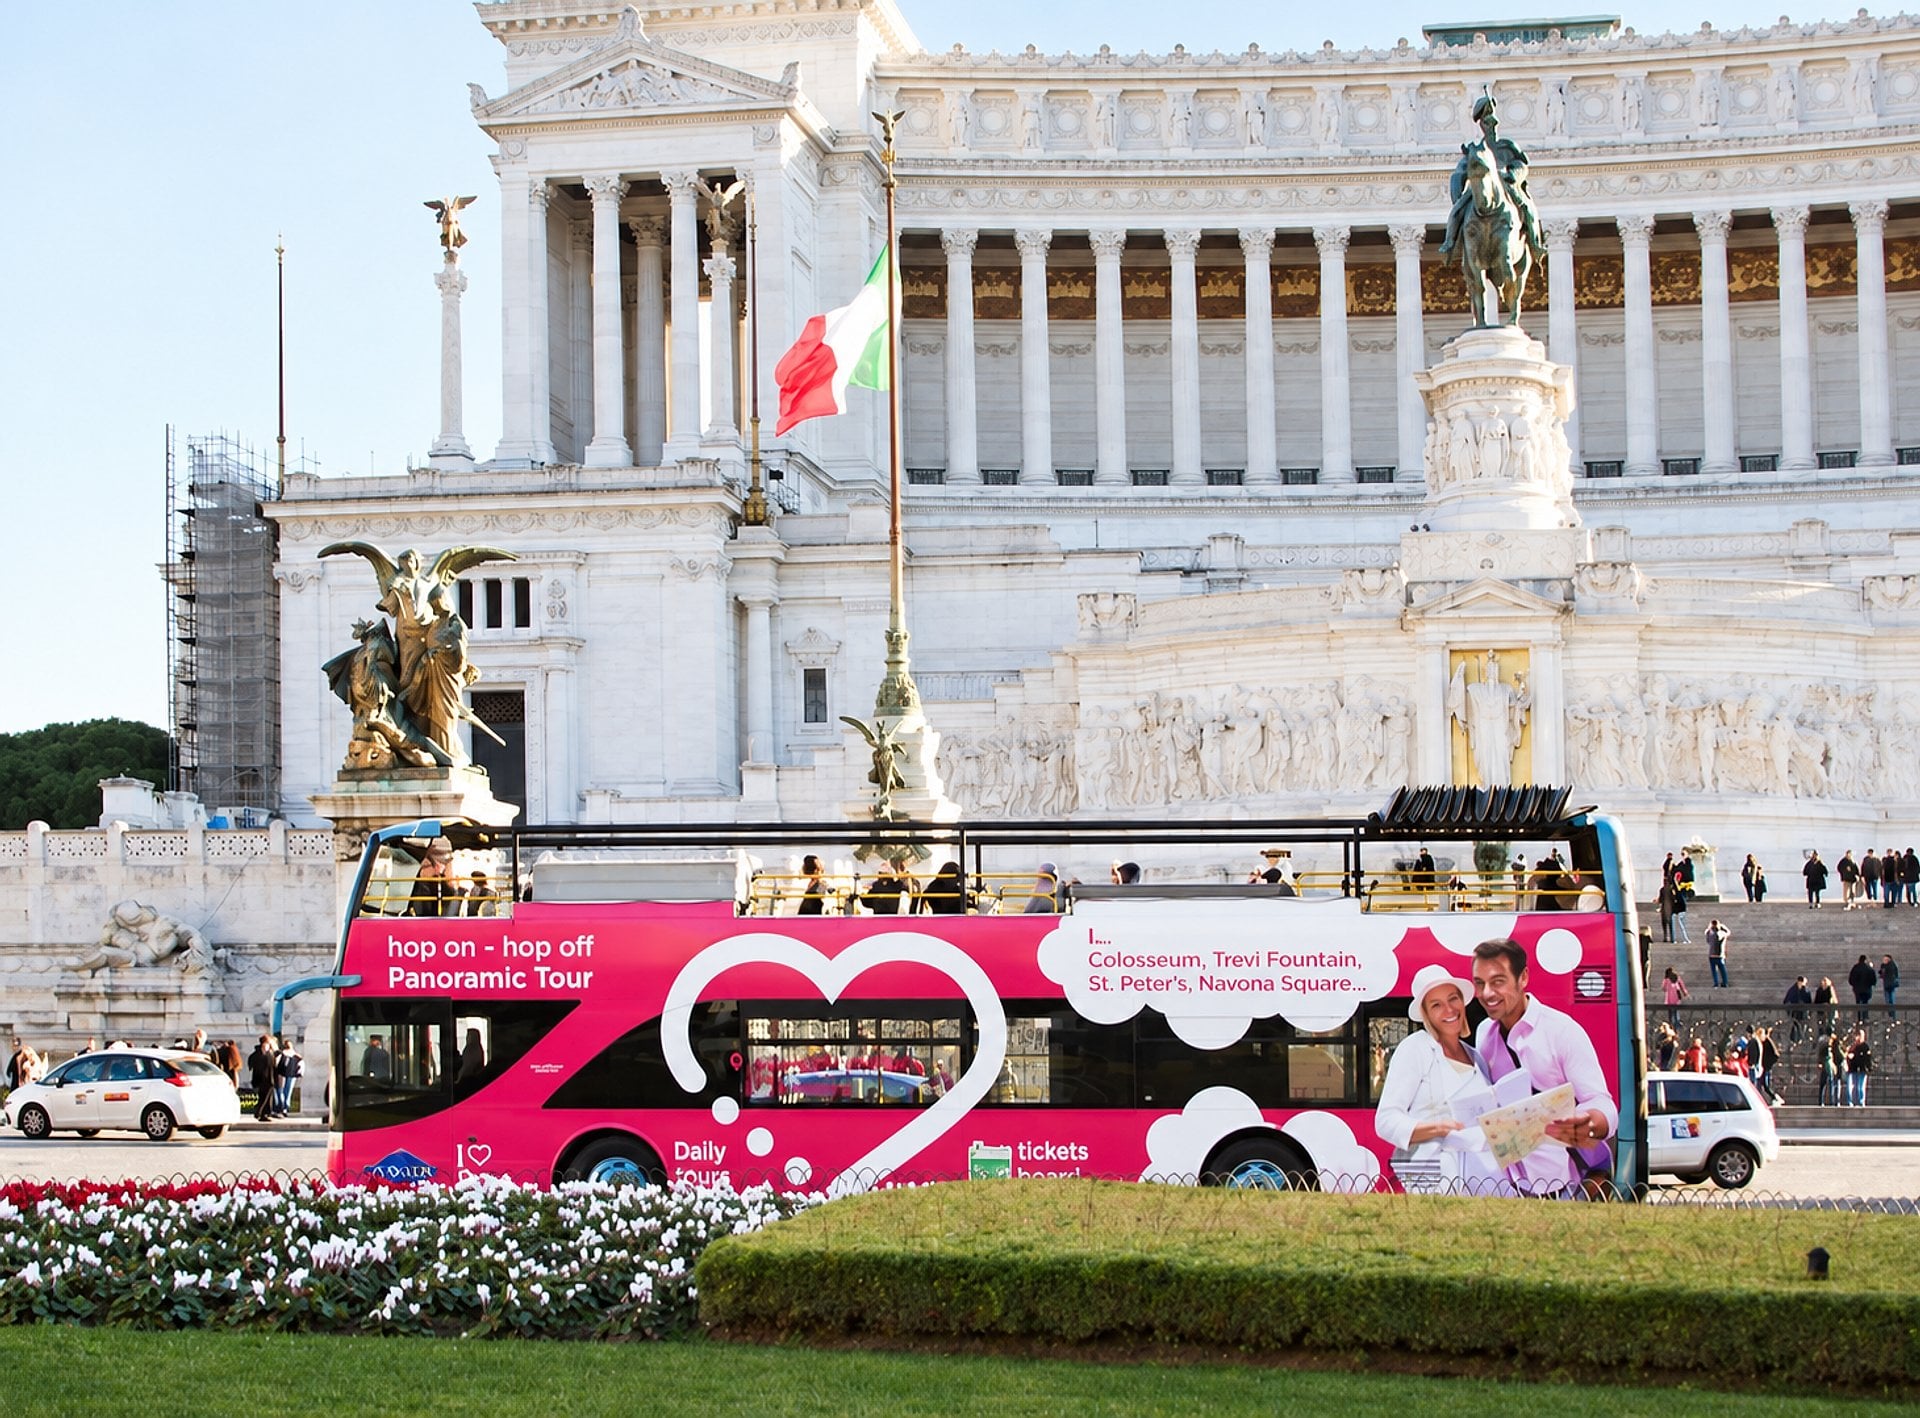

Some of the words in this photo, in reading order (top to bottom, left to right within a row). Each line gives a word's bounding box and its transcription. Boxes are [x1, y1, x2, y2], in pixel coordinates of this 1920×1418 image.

[388, 935, 437, 962] hop
[444, 940, 476, 958] on
[503, 935, 552, 962] hop
[559, 935, 594, 958] off
[1088, 951, 1206, 970] Colosseum,
[1212, 951, 1260, 968] Trevi
[1267, 951, 1361, 970] Fountain,
[388, 966, 527, 989] Panoramic
[534, 966, 593, 989] Tour
[1089, 975, 1114, 992] St.
[1121, 975, 1192, 994] Peter's,
[1199, 975, 1275, 992] Navona
[1281, 975, 1367, 995] Square...
[674, 1140, 727, 1165] Daily
[1017, 1140, 1089, 1161] tickets
